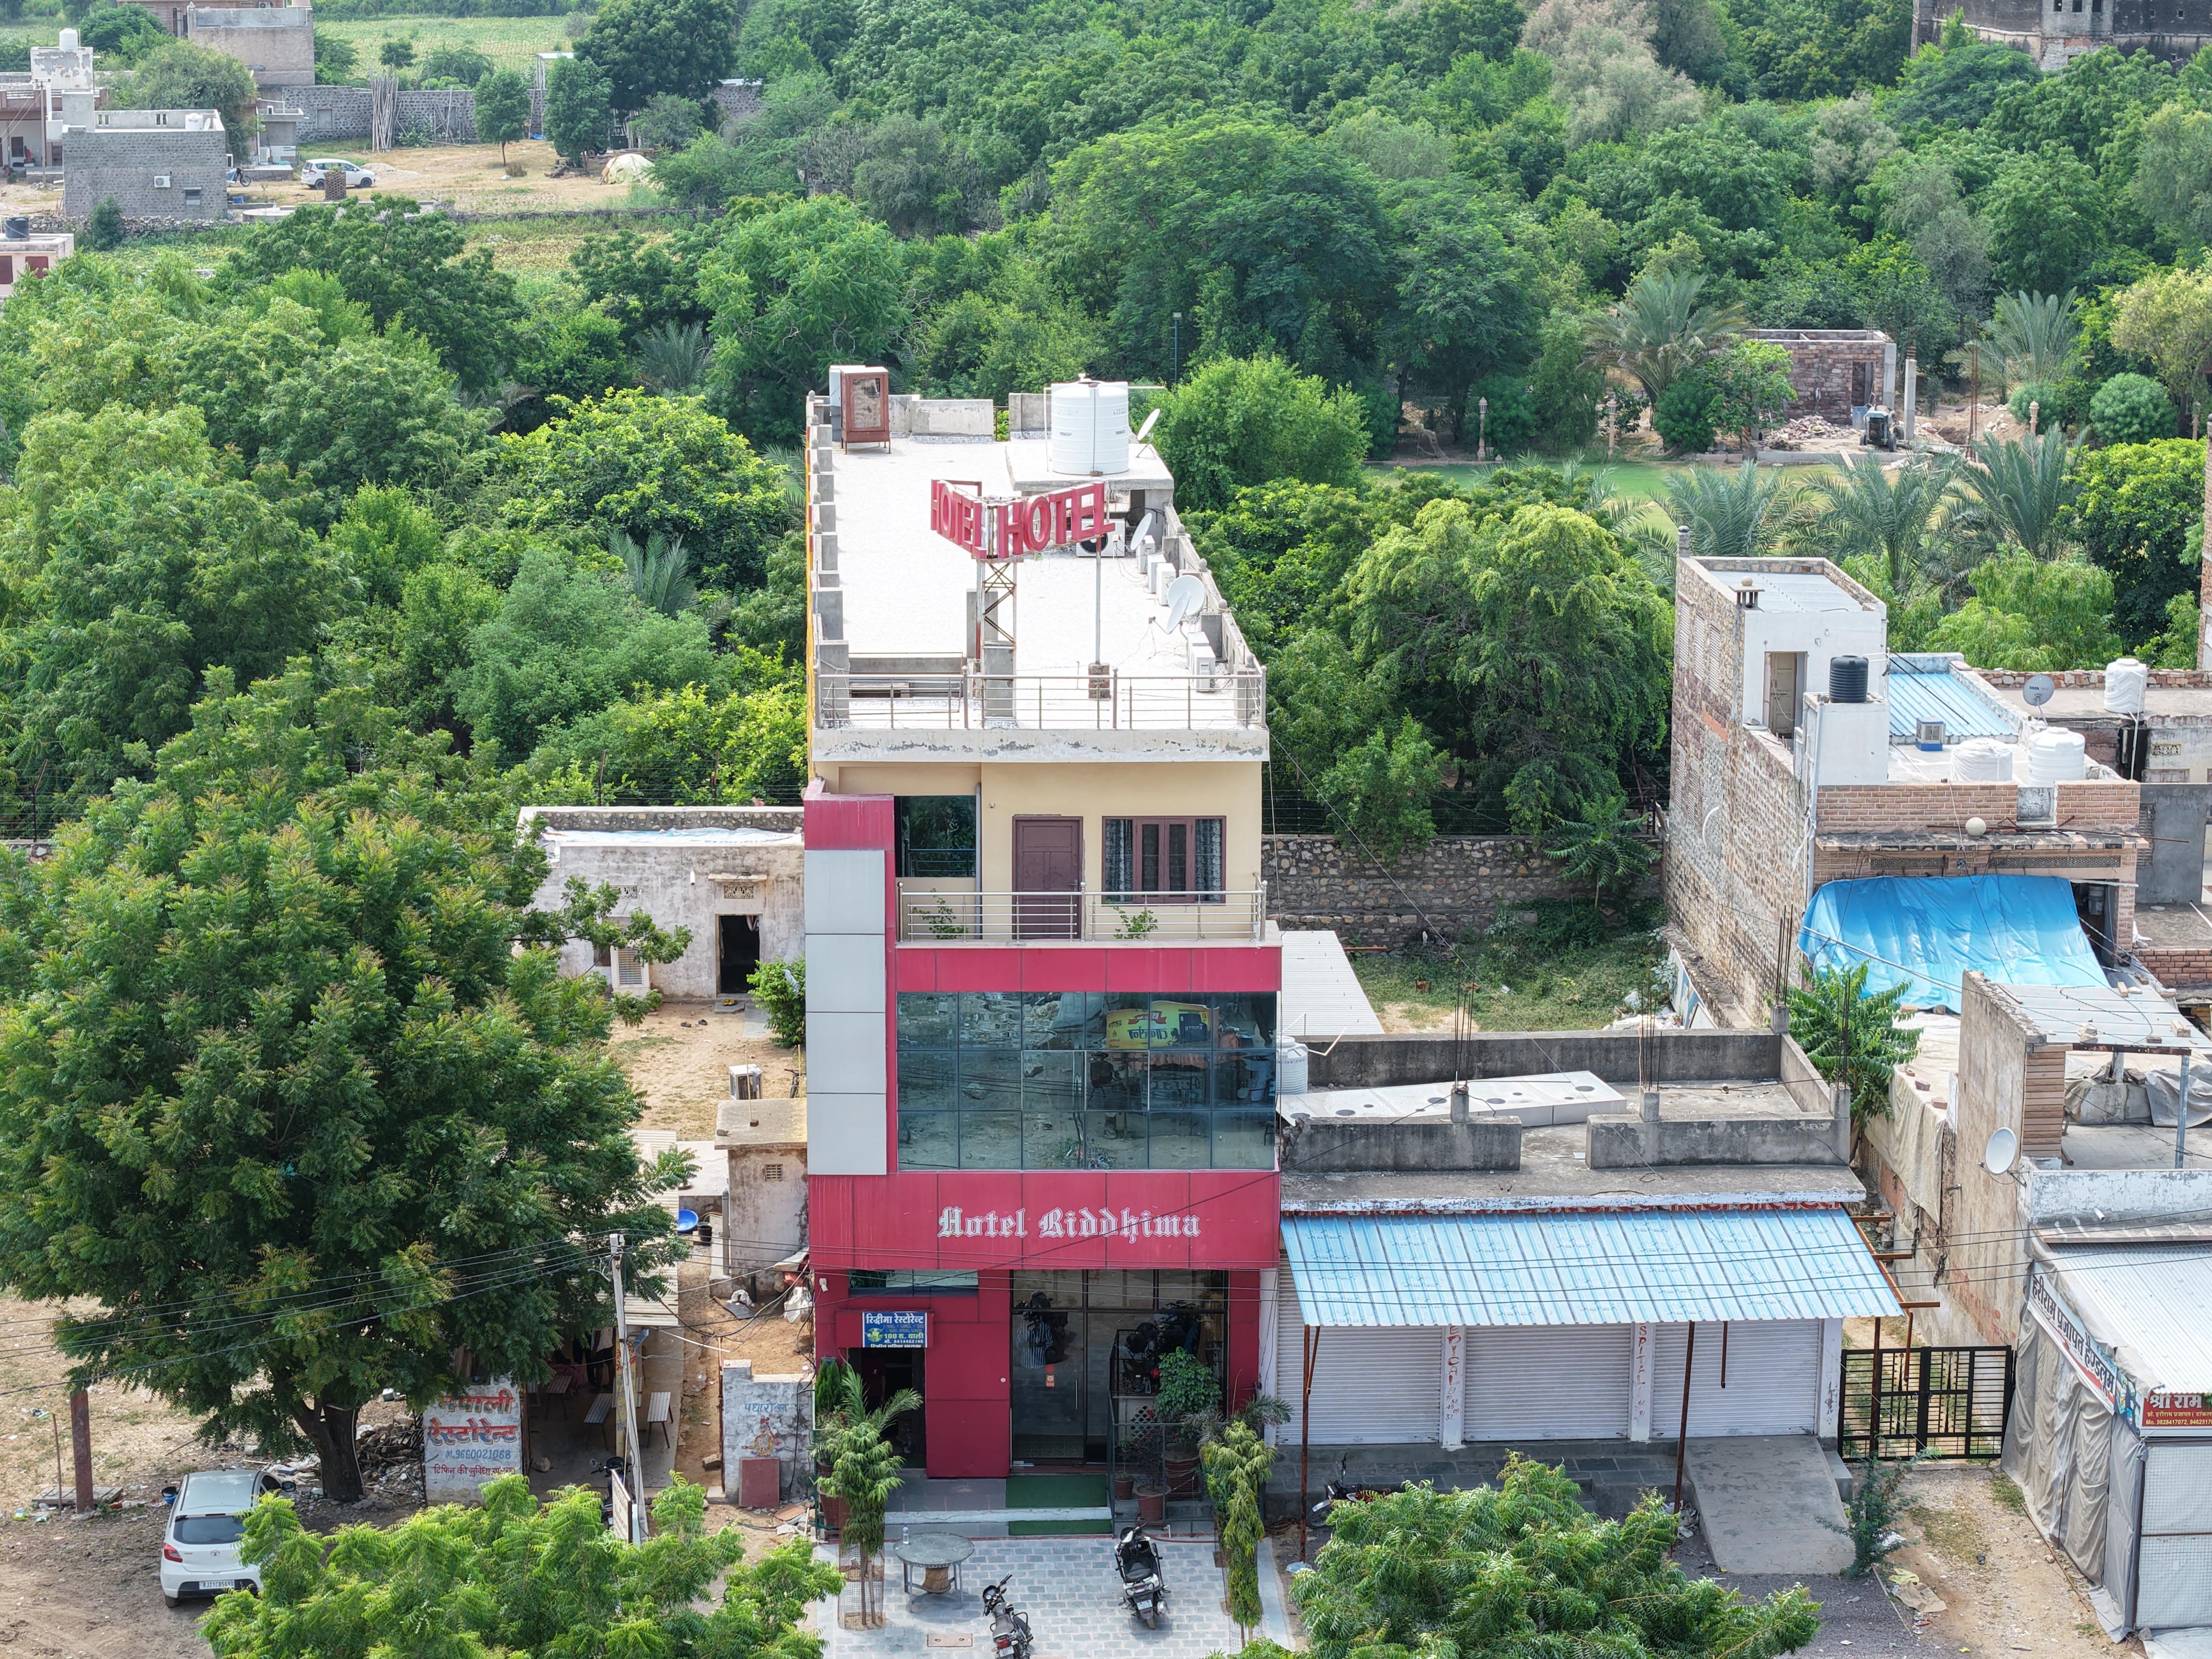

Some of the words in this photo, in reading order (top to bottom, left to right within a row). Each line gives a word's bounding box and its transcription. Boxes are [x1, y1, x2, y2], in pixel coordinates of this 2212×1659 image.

[931, 479, 987, 558] HOTEL
[998, 481, 1115, 559] HOTEL
[937, 1206, 1028, 1238] Hotel
[1039, 1206, 1201, 1244] Riddhima
[2032, 1275, 2057, 1321] हरीराम
[1447, 1325, 1462, 1385] EDICAL
[438, 1388, 515, 1414] नपाली
[2174, 1394, 2202, 1408] राम
[457, 1464, 467, 1475] की
